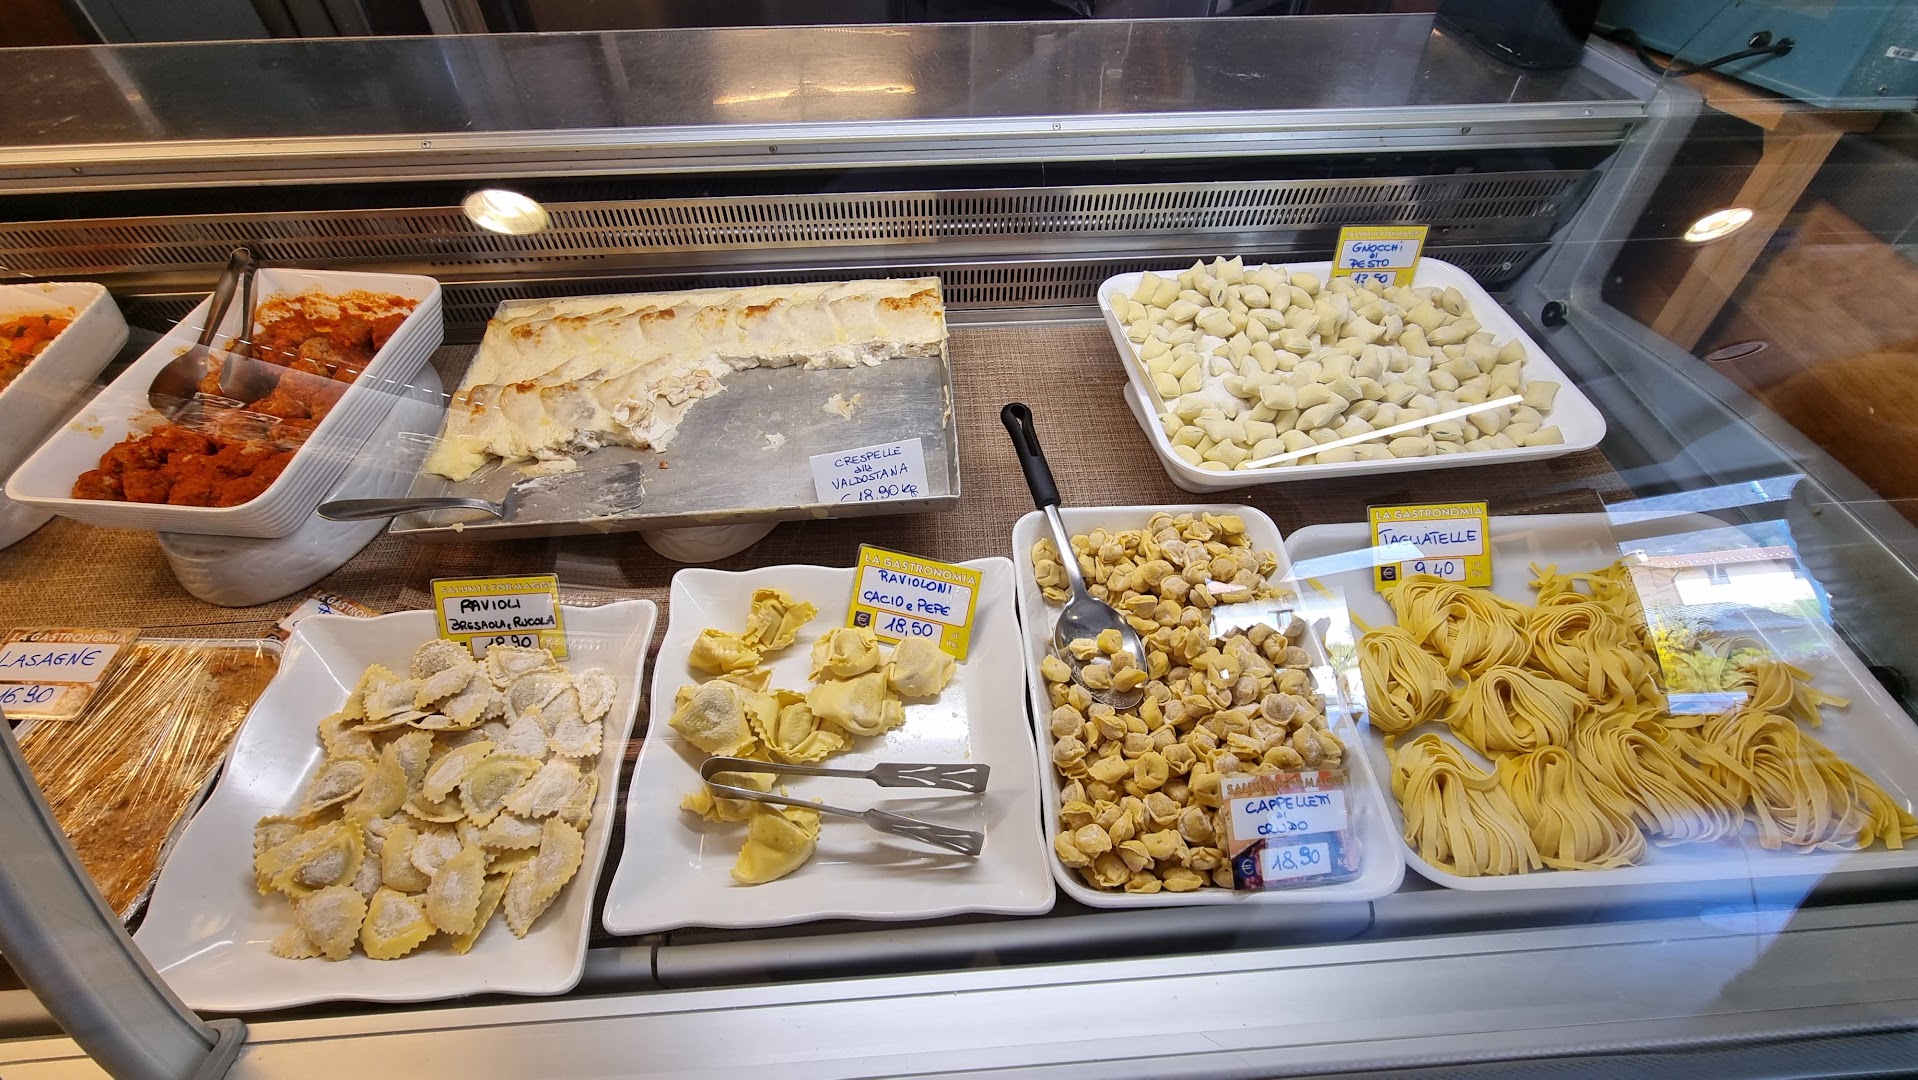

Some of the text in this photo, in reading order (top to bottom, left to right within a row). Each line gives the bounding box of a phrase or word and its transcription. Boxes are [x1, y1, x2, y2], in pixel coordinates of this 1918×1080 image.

[1349, 259, 1390, 269] PESTO
[834, 446, 901, 468] CRESPELLE
[831, 462, 908, 490] VALDOSTANA
[1376, 506, 1483, 520] LA GASTRONOMIA
[1378, 528, 1477, 546] TAGLIATELLE
[865, 553, 977, 586] LA GASTRONOMIA
[441, 581, 552, 594] SALUMI E FORMAGGI
[878, 569, 952, 594] RAVIOLONI
[313, 590, 327, 599] LA
[327, 596, 373, 619] GASTRON
[460, 598, 521, 614] RAVIOLI
[863, 590, 904, 607] CACIO
[917, 598, 951, 617] PEPE
[448, 618, 506, 631] BRESAOLA
[513, 615, 555, 628] RUCOLA
[884, 617, 933, 637] 18,50
[13, 632, 128, 643] LA GASTRONOMIA
[0, 647, 102, 668] LASAGNE
[1257, 821, 1308, 835] CRUDO
[1272, 846, 1320, 871] 18,90
